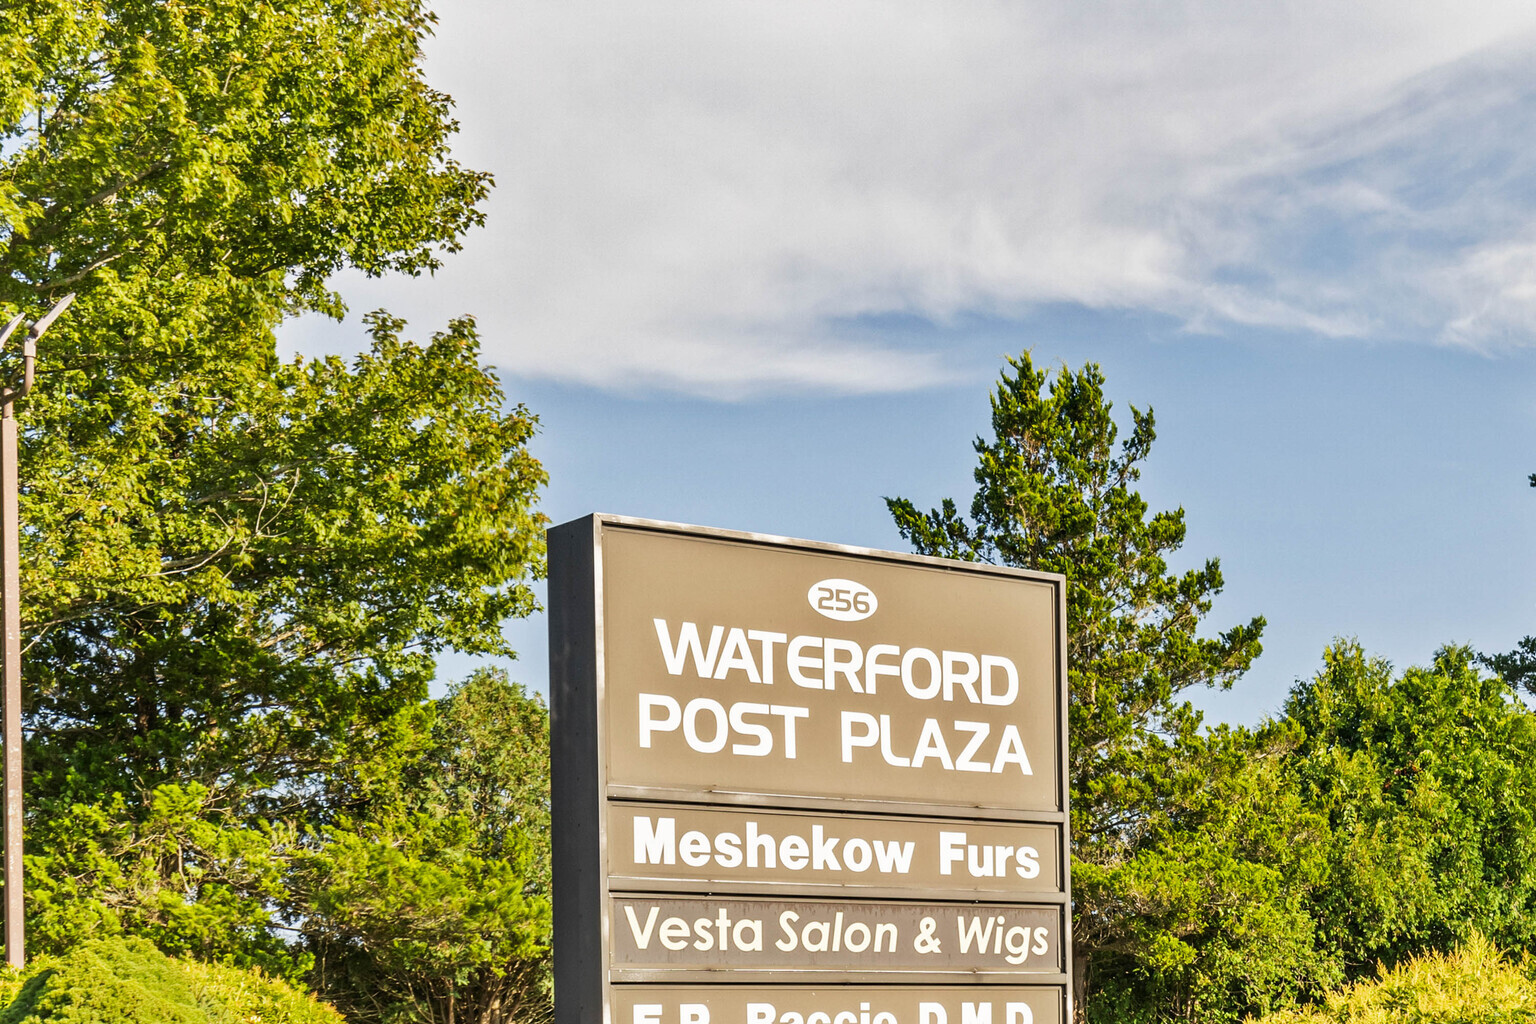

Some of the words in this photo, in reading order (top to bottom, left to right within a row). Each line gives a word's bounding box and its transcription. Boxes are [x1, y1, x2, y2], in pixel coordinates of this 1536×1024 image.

[817, 586, 870, 614] 256
[653, 618, 1020, 706] WATERFORD
[637, 692, 810, 760] POST
[840, 710, 1033, 776] PLAZA
[632, 815, 916, 875] Meshekow
[938, 830, 1041, 880] Furs
[623, 905, 764, 953] Vesta
[774, 910, 899, 954] Salon
[913, 916, 943, 955] &
[956, 914, 1050, 966] Wigs
